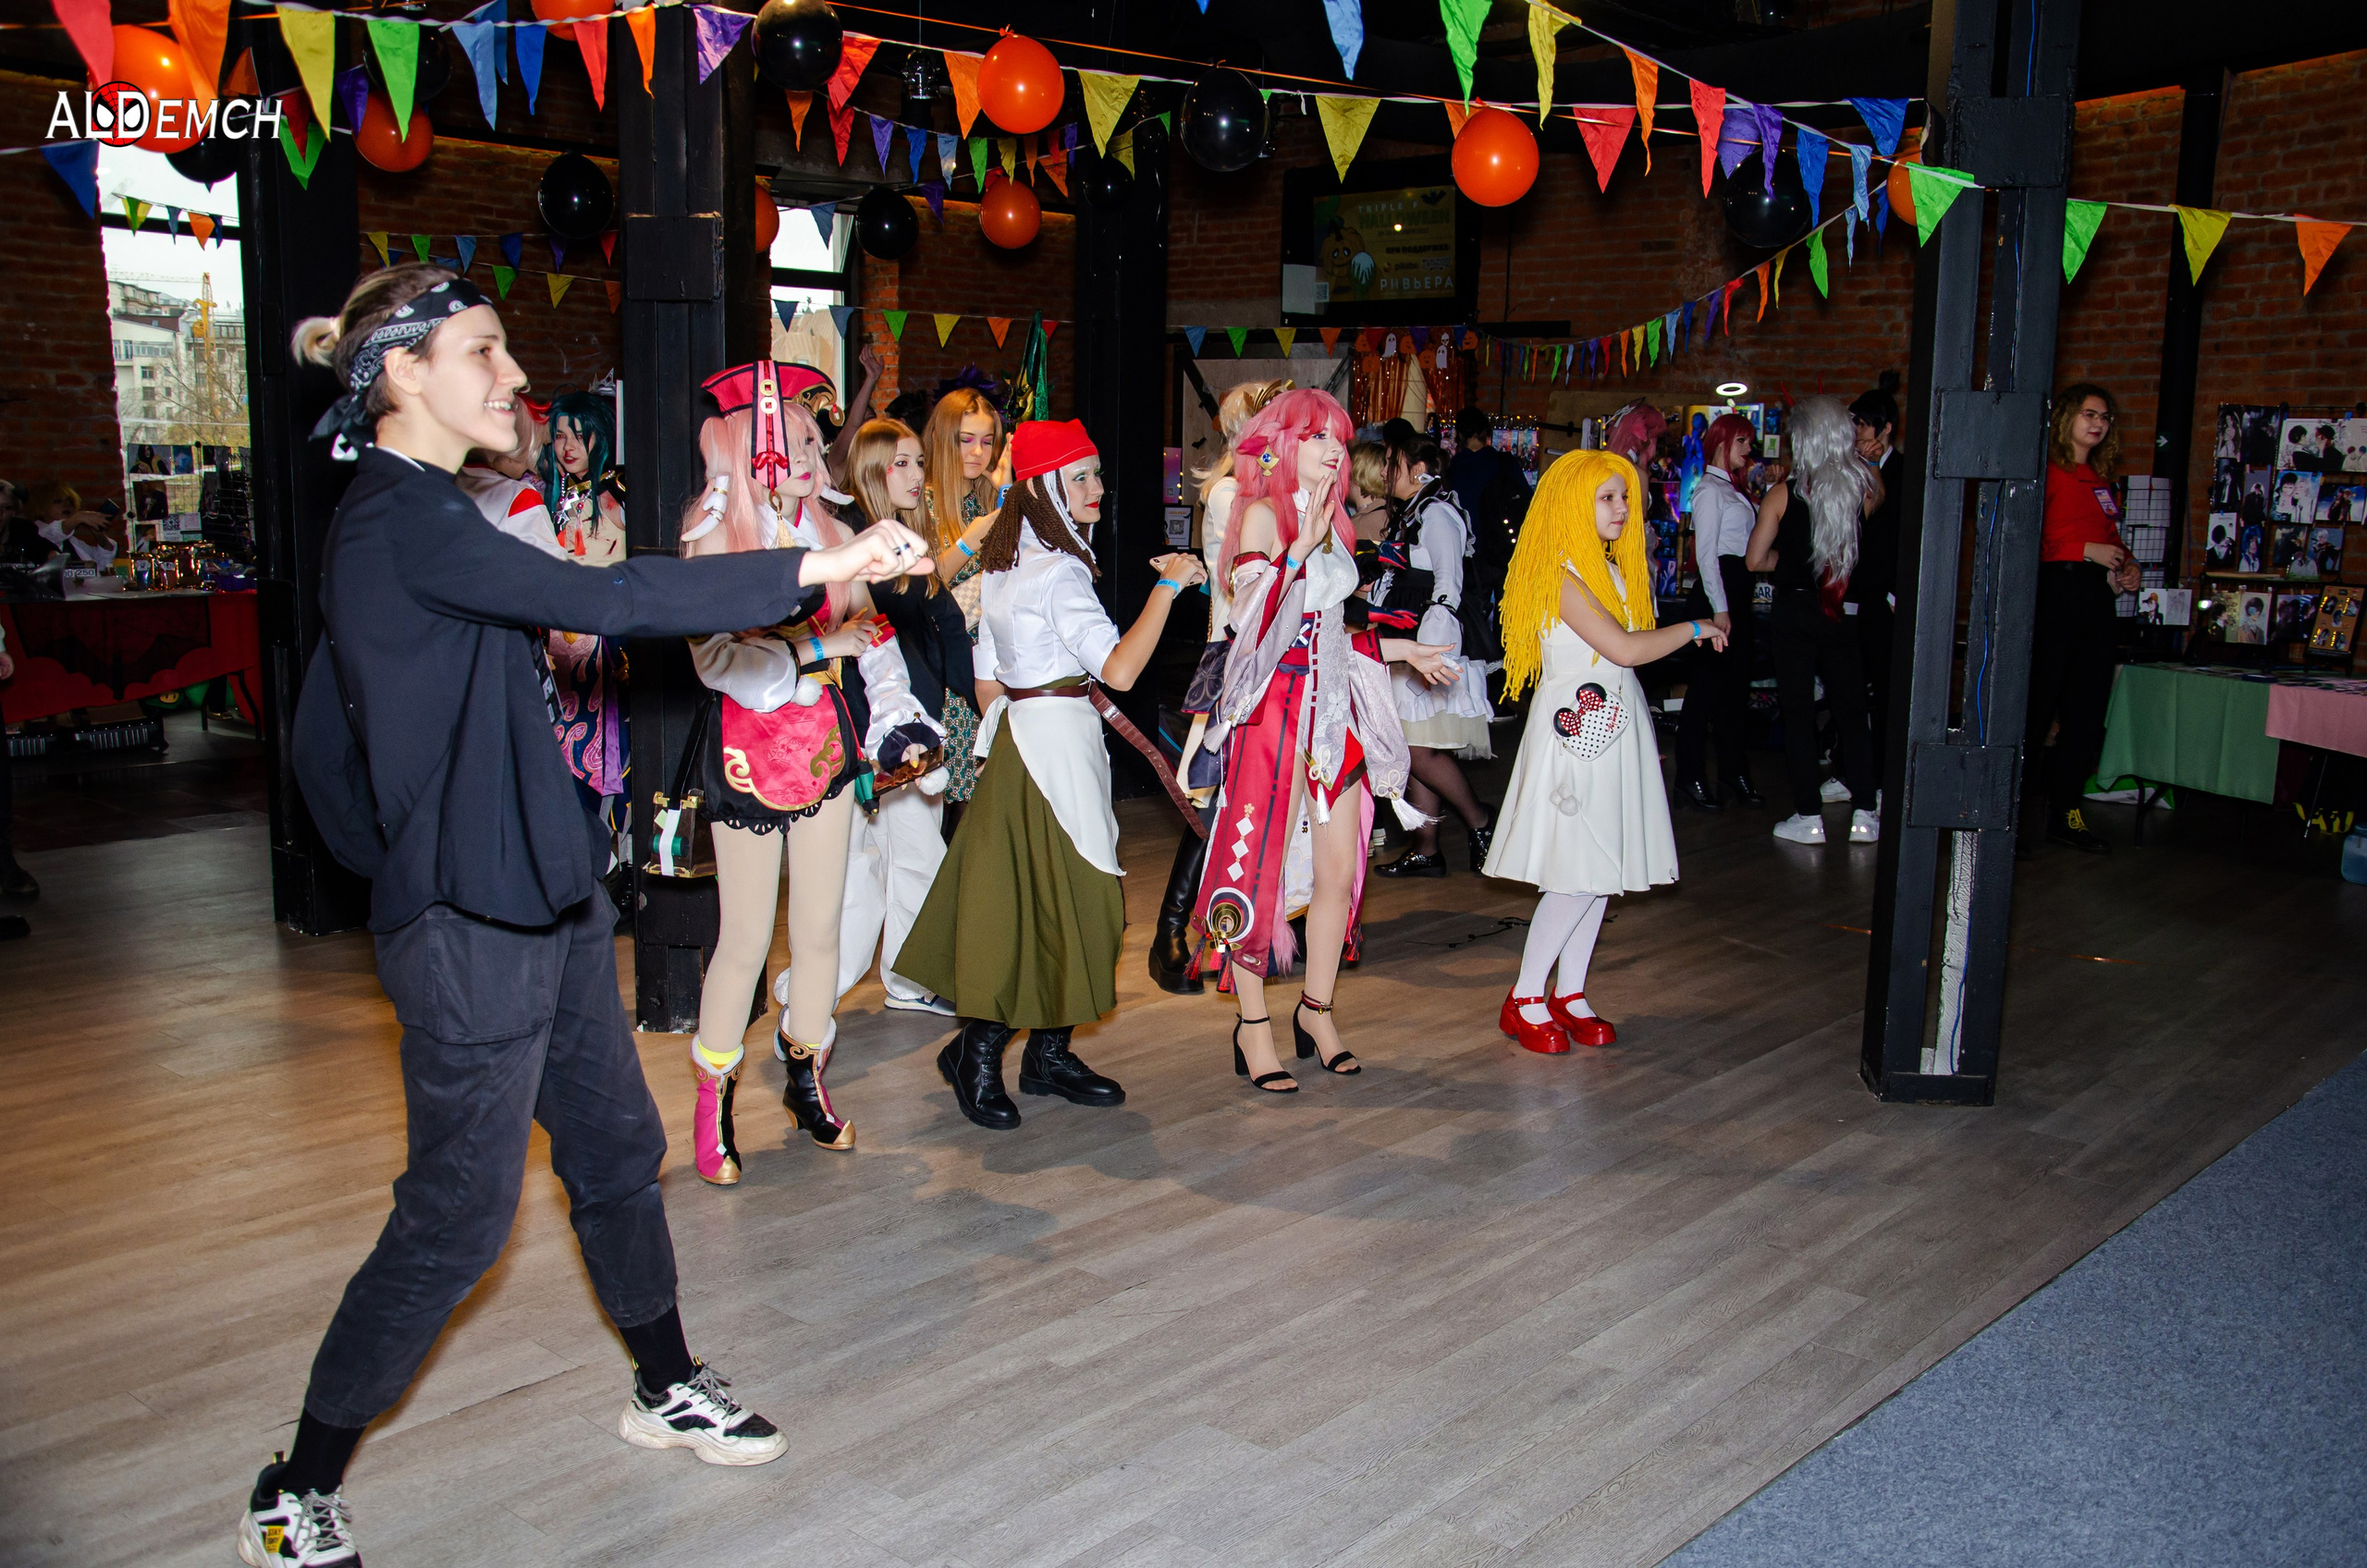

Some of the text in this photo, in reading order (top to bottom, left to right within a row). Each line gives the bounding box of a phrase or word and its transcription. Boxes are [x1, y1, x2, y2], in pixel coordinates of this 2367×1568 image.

[1358, 201, 1418, 214] TRIPLE F
[1358, 208, 1450, 229] HALLOWEEN
[1380, 276, 1454, 291] РИВЬЕРА
